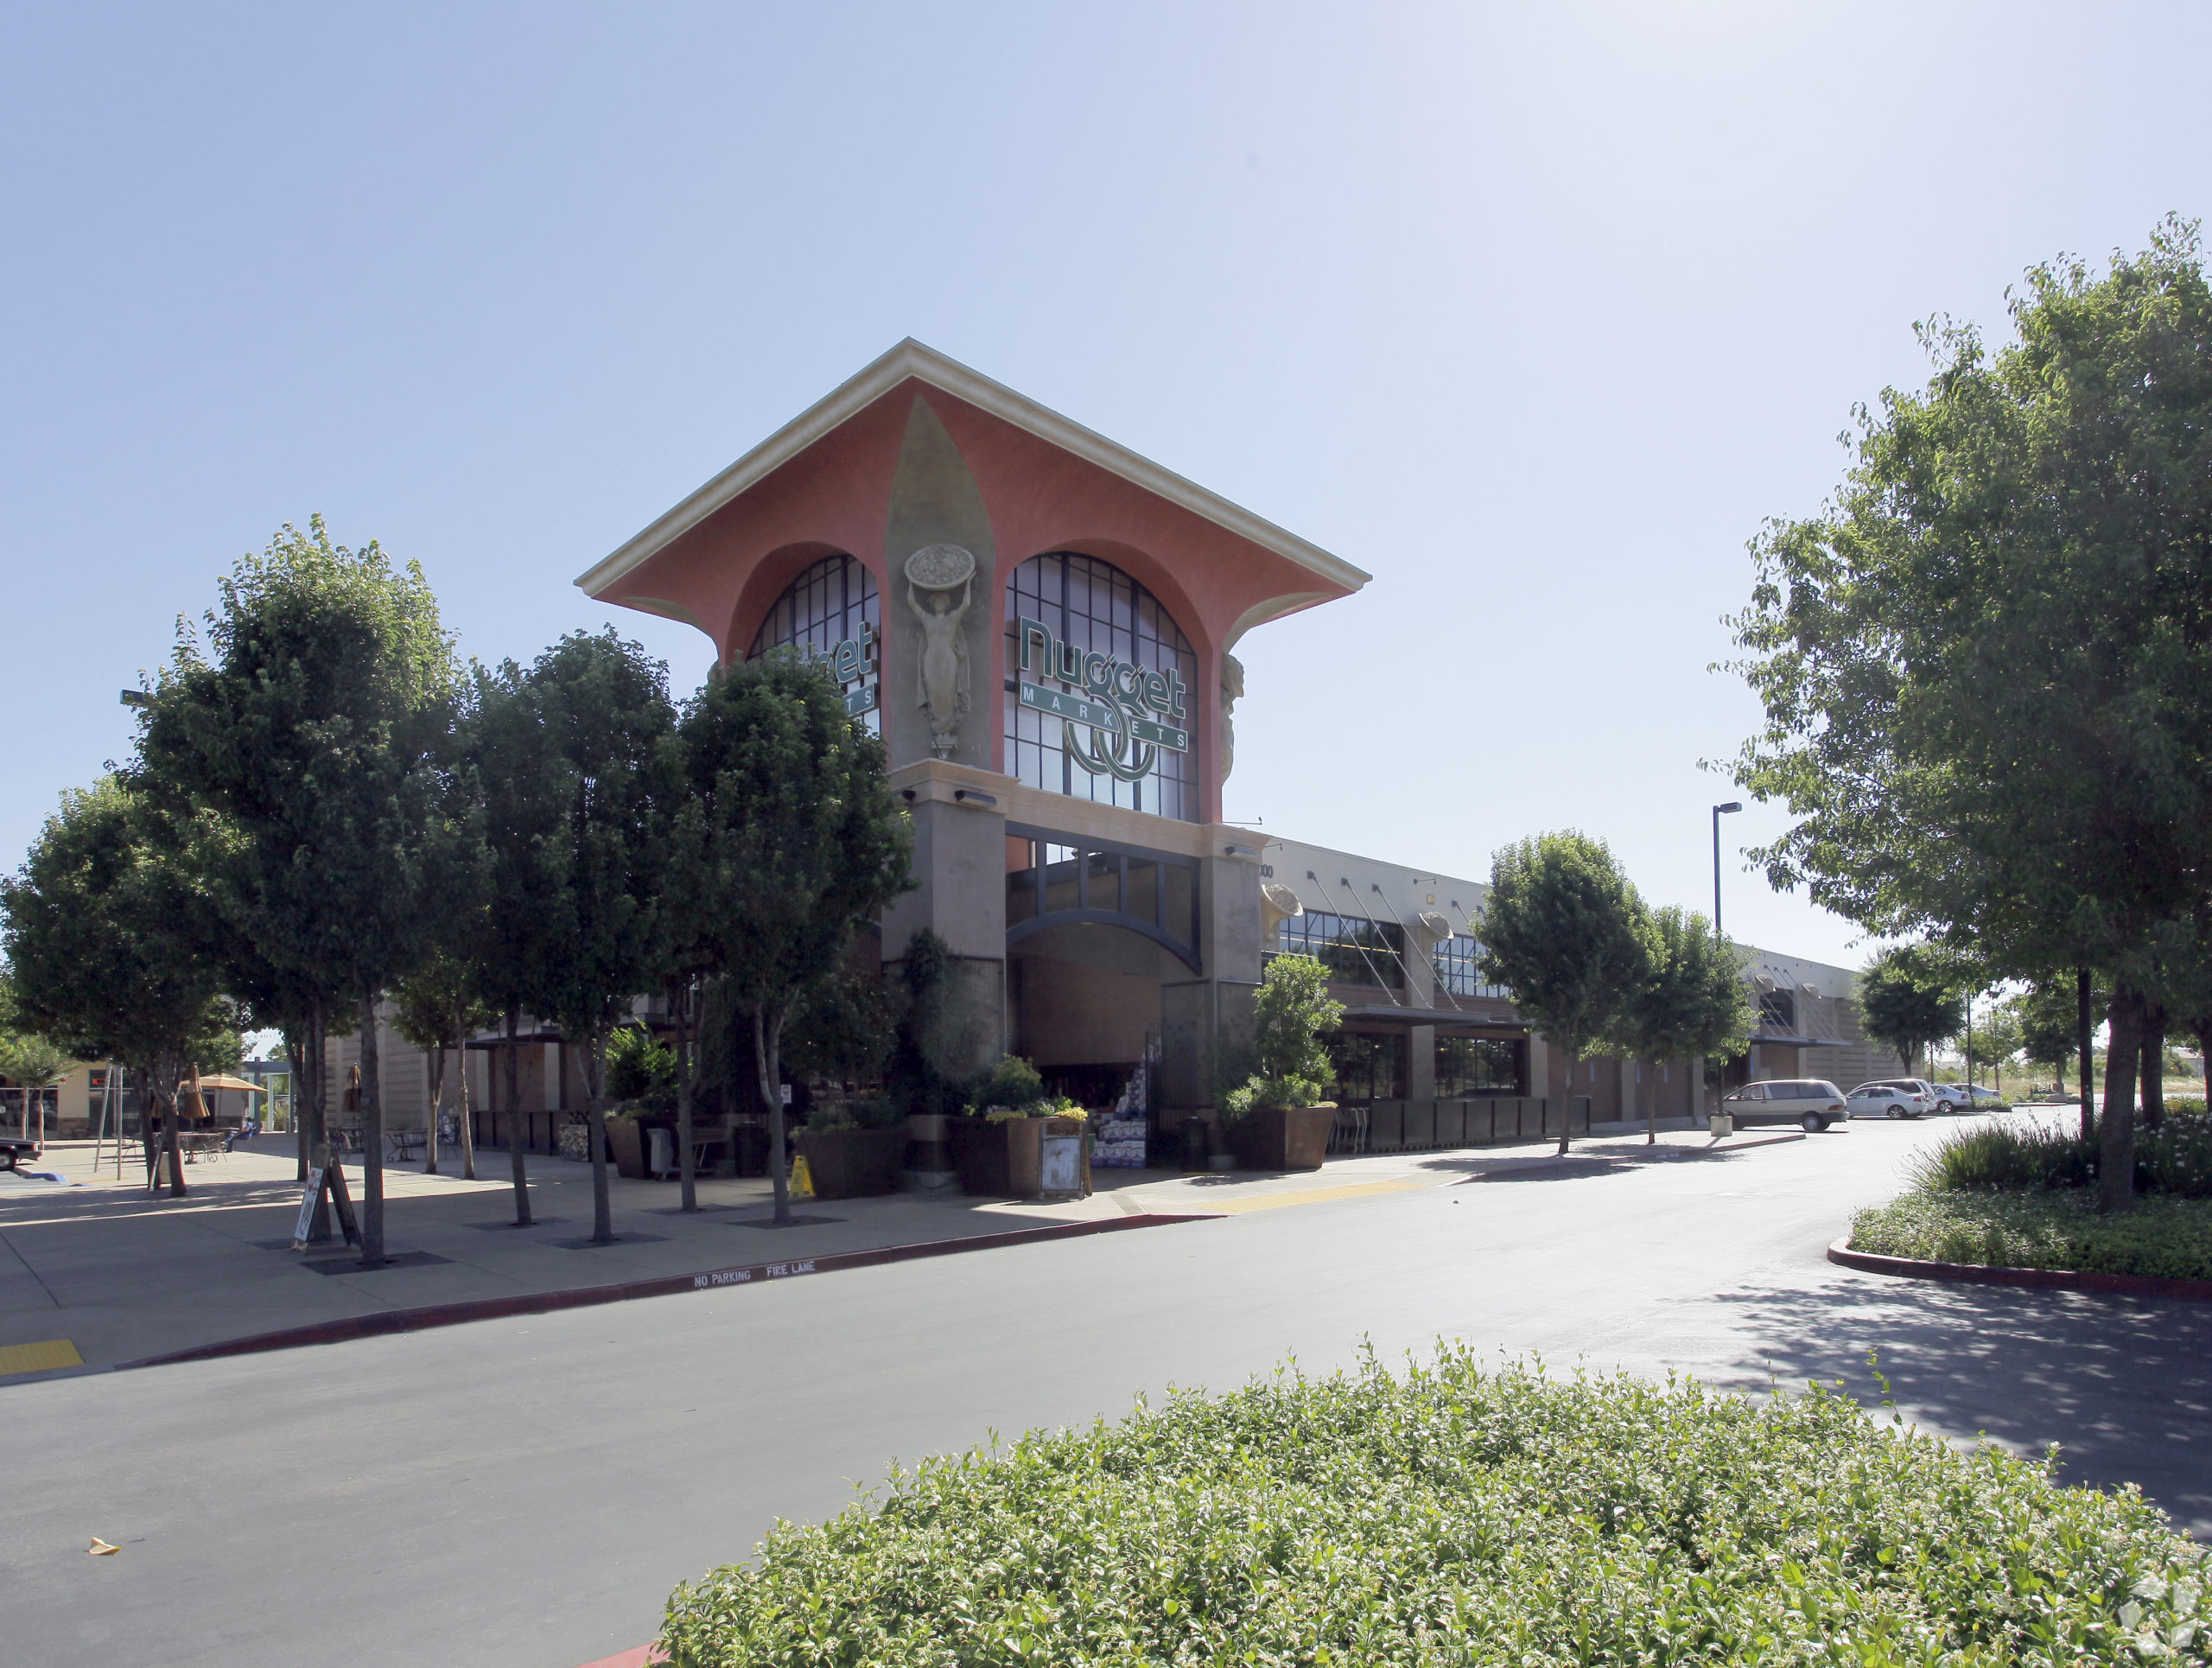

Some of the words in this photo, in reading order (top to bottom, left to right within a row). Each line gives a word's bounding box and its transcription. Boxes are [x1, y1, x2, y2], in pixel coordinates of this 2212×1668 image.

[1023, 686, 1185, 747] MARKETS
[694, 1276, 708, 1287] NO
[712, 1270, 751, 1284] PARKING
[766, 1264, 788, 1276] FIRE
[791, 1261, 816, 1274] LANE
